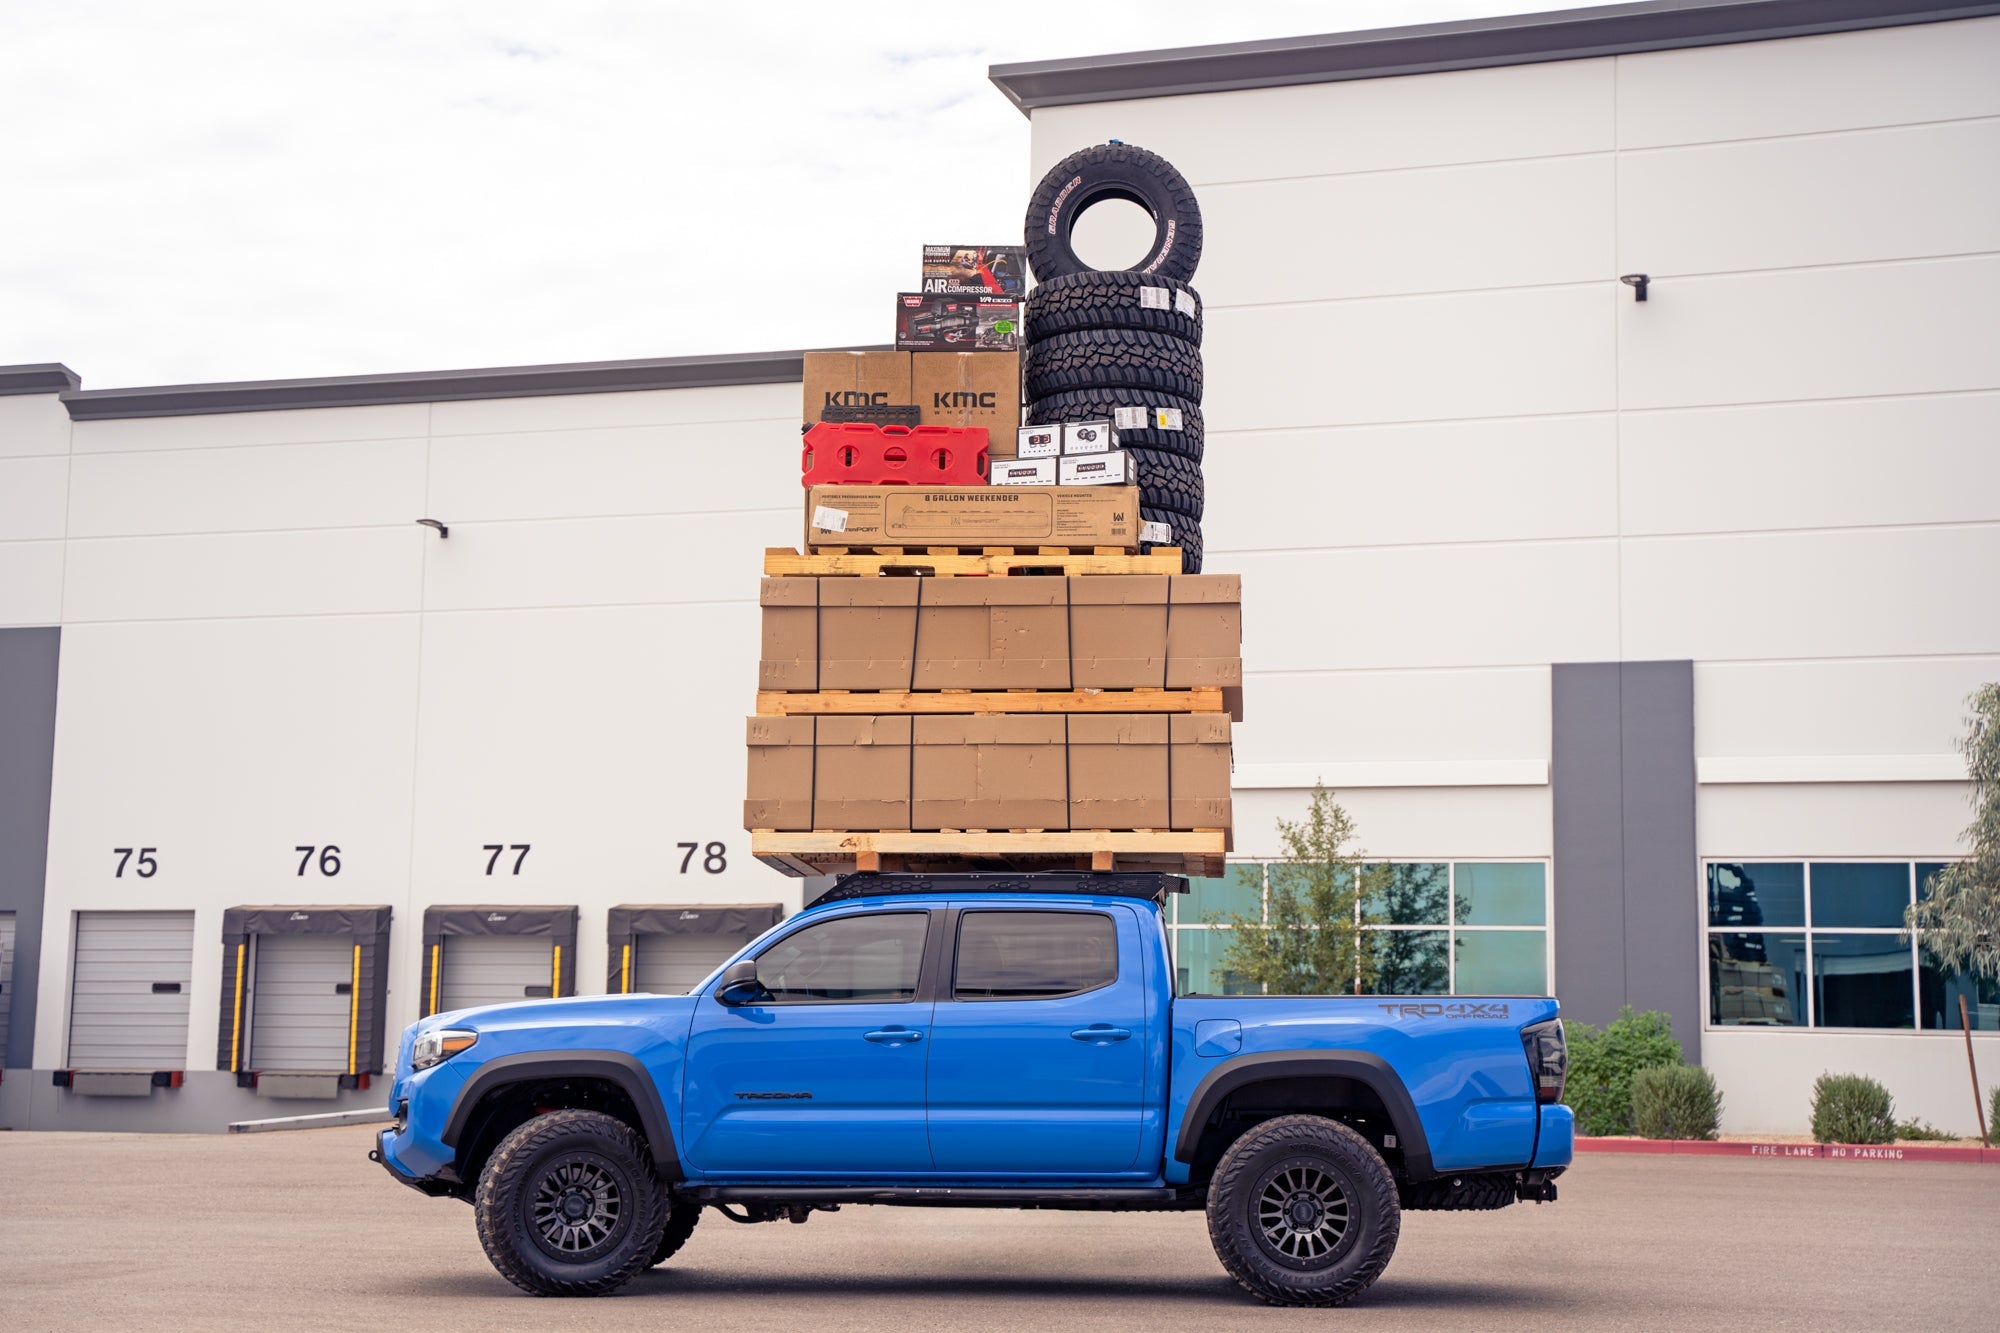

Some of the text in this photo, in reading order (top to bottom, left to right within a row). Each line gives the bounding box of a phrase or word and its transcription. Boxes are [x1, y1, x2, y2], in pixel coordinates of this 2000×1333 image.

[1048, 176, 1082, 235] GRABBER
[924, 279, 948, 293] AIR
[947, 285, 993, 294] COMPRESSOR
[113, 847, 158, 878] 75
[295, 845, 341, 877] 76
[482, 844, 531, 875] 77
[676, 841, 727, 874] 78
[734, 1091, 813, 1099] TACOMA
[1751, 1145, 1903, 1160] FIRE LANE NO PARKING
